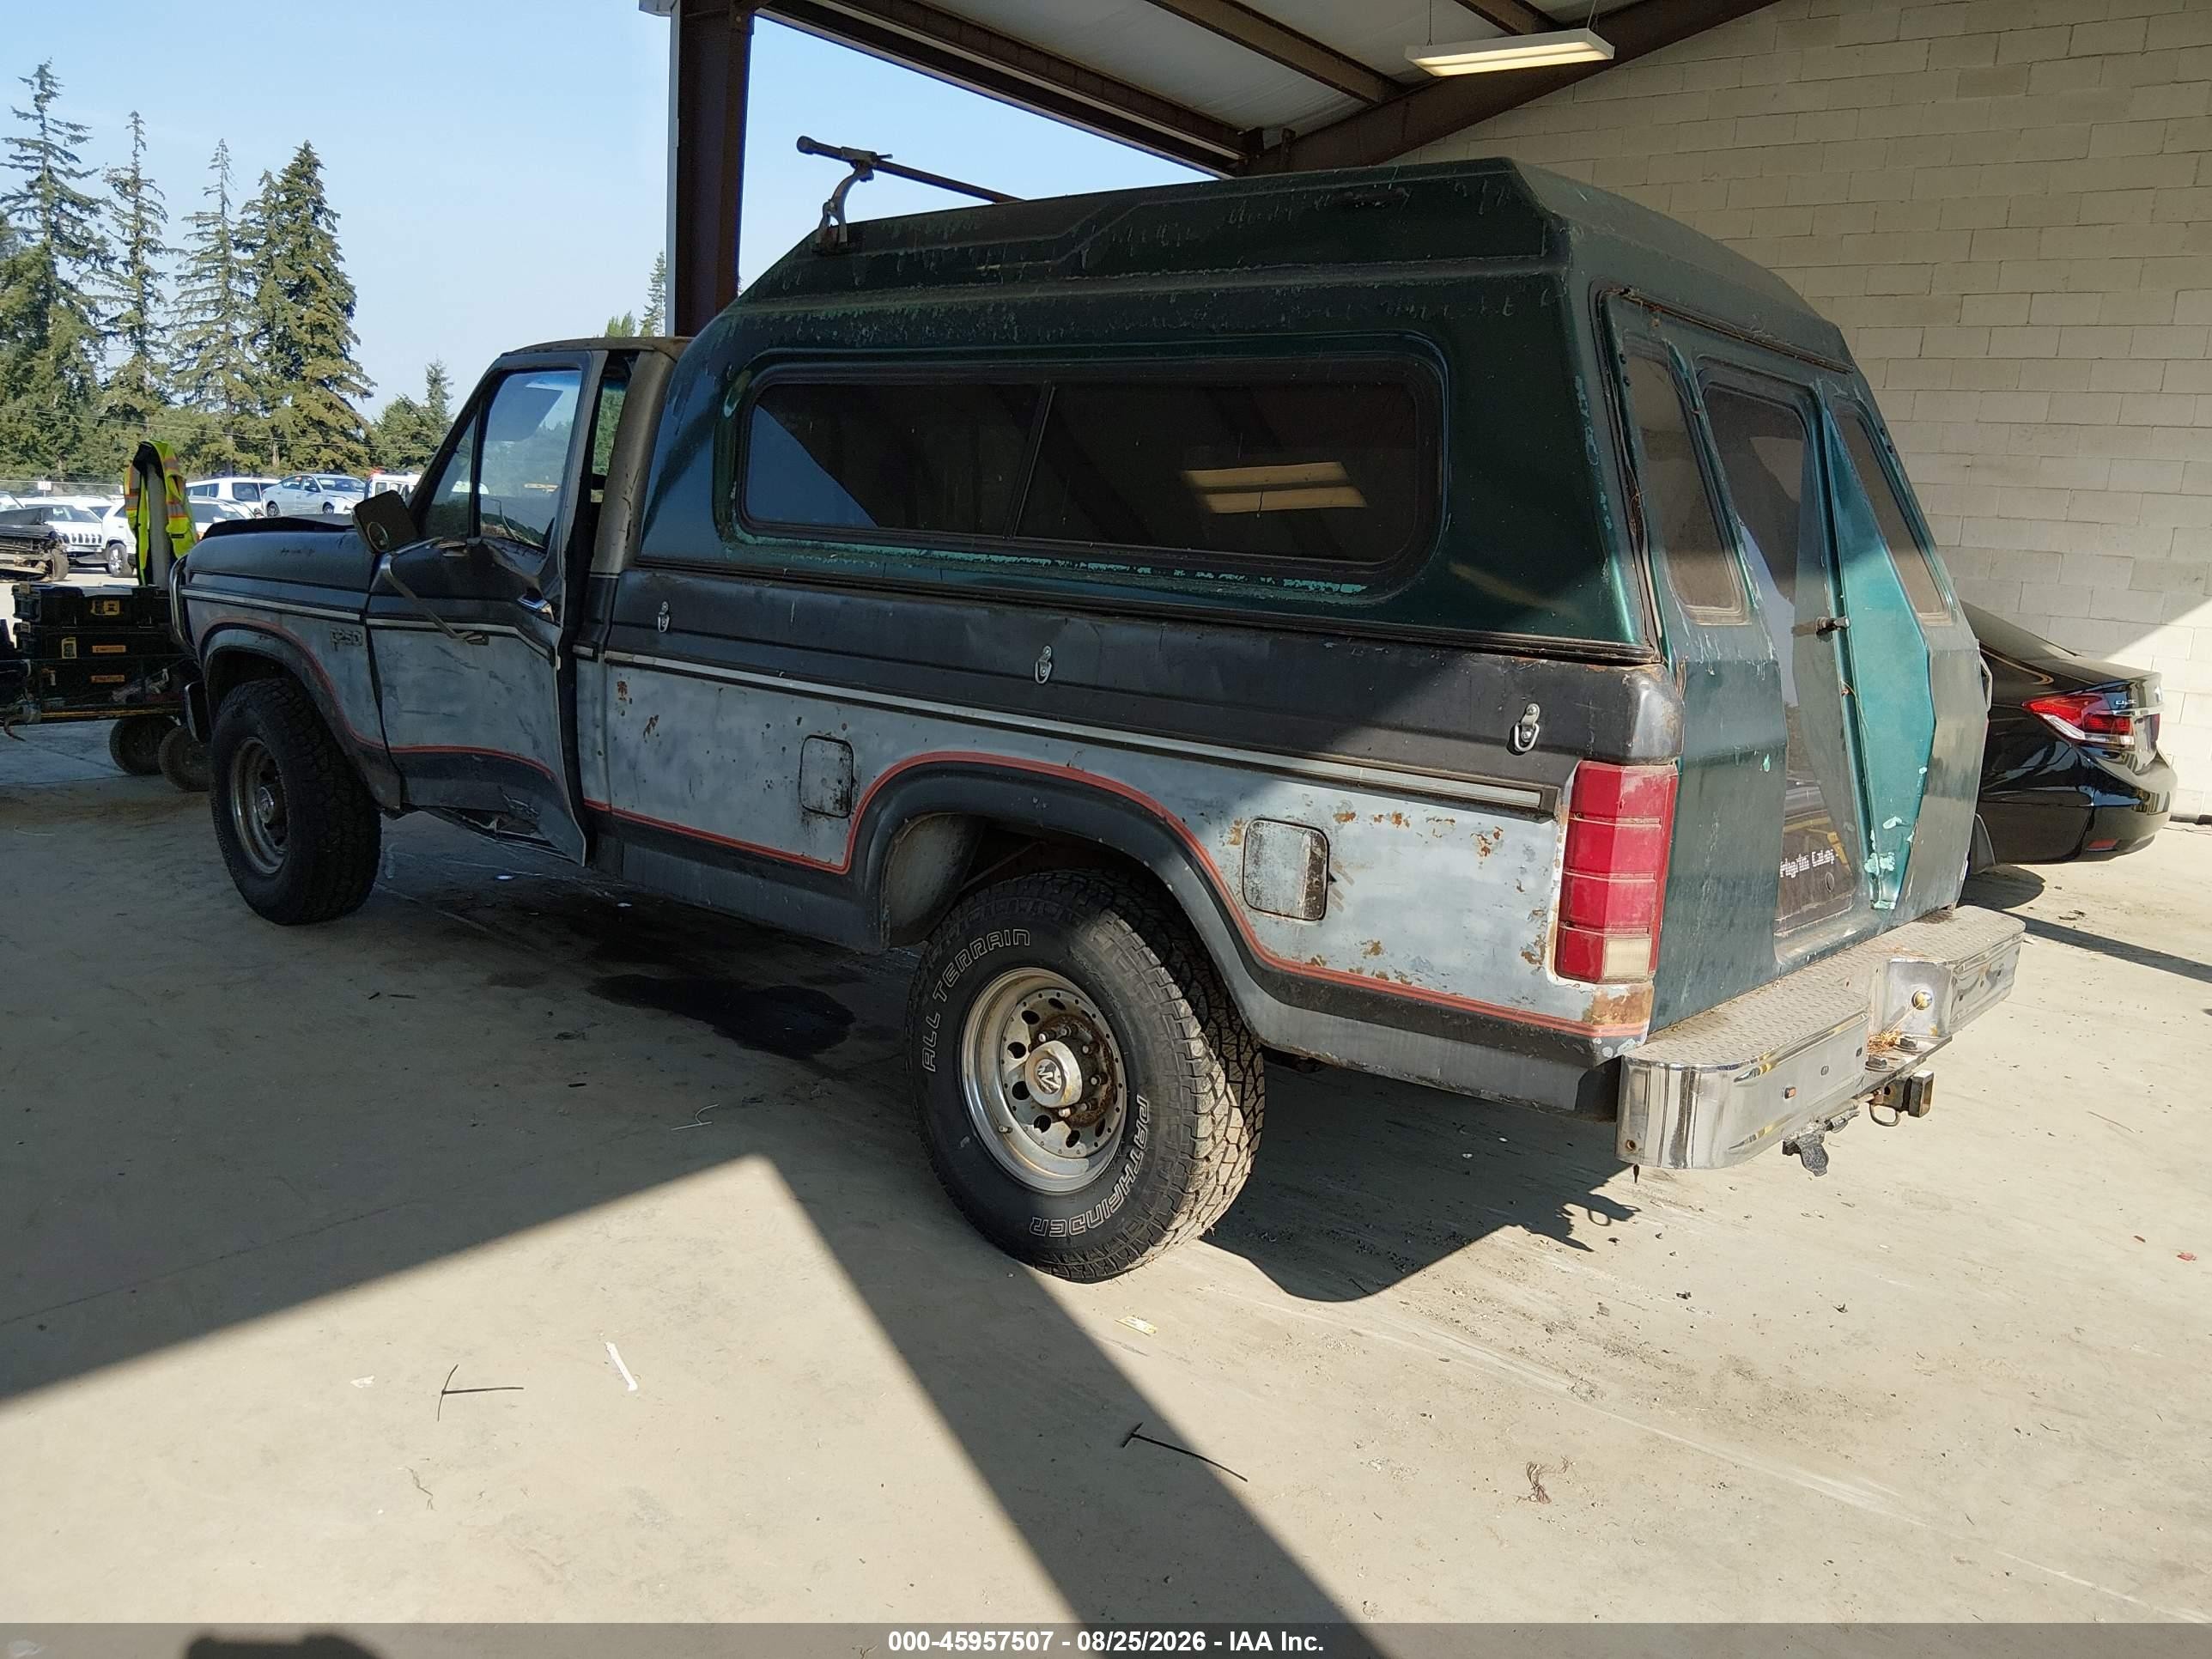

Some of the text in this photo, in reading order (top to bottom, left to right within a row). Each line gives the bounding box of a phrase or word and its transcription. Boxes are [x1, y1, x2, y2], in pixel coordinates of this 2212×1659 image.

[921, 928, 1030, 1072] ALL TERRAIN
[1030, 1094, 1149, 1237] PATHFINDER
